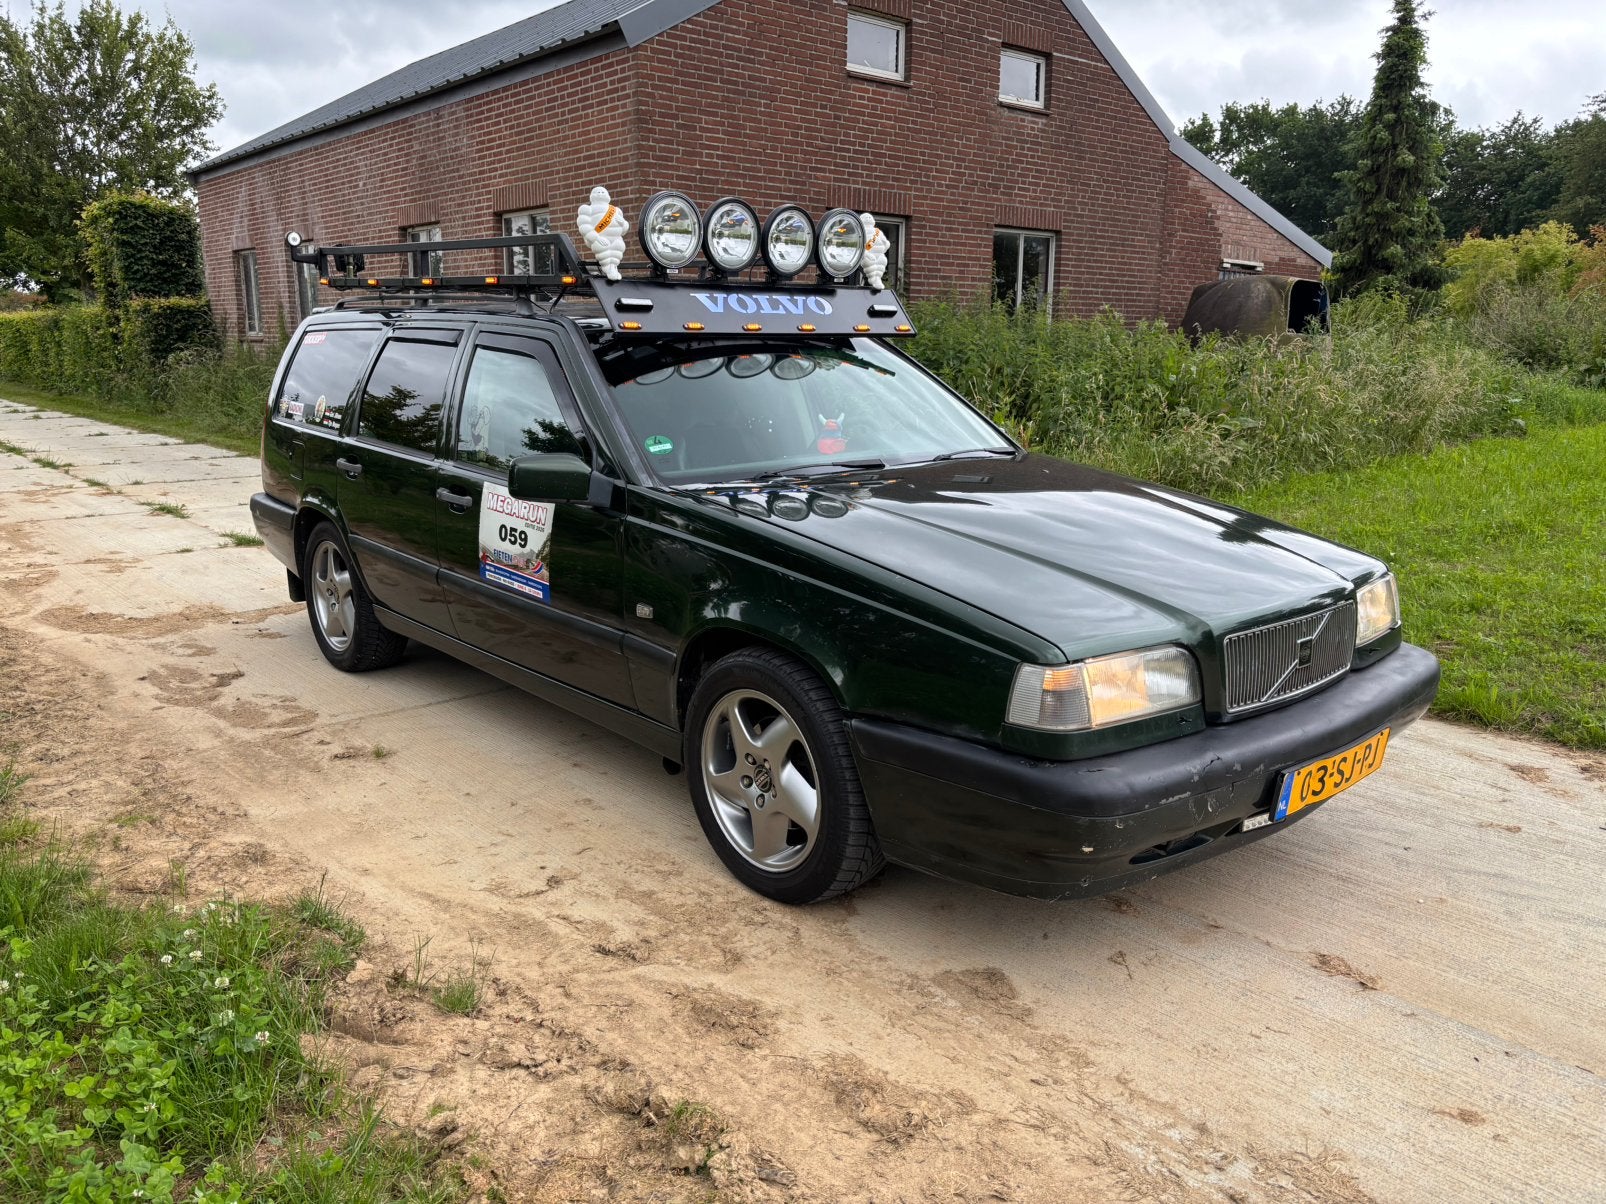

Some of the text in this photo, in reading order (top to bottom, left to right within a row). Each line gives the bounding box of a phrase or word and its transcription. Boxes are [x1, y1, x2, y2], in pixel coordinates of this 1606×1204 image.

[690, 293, 833, 315] VOLVO
[487, 492, 548, 526] MEGARUN
[499, 524, 529, 549] 059
[1301, 738, 1380, 803] 03-SJ-PJ
[1279, 800, 1287, 810] NL
